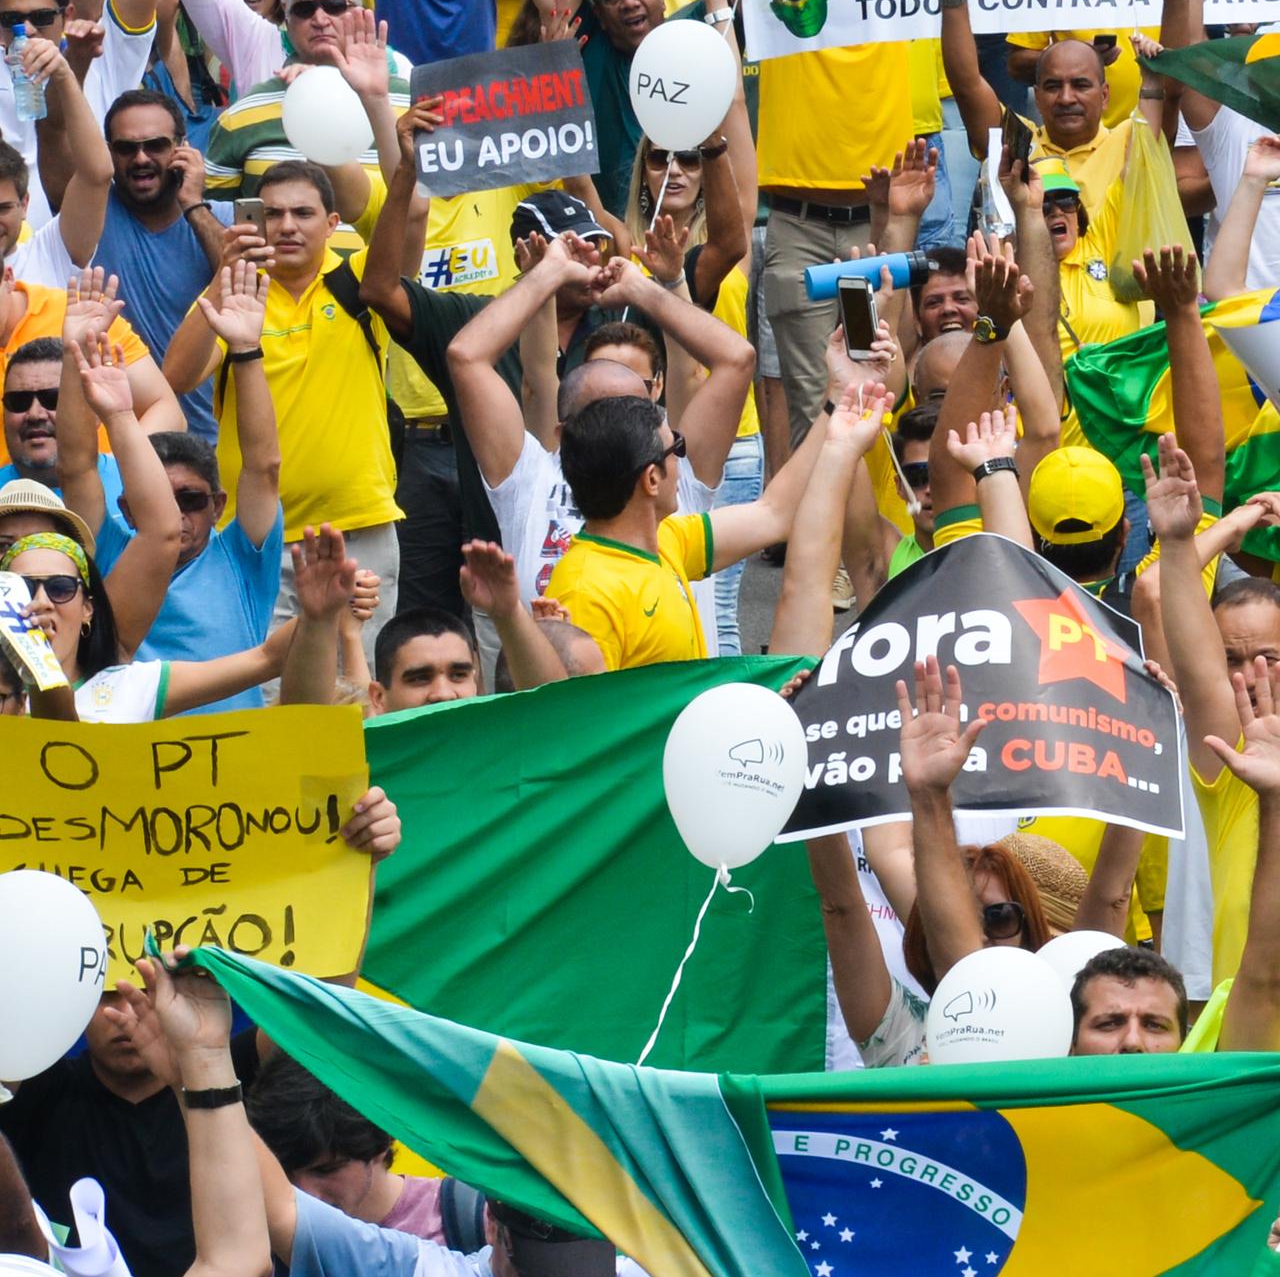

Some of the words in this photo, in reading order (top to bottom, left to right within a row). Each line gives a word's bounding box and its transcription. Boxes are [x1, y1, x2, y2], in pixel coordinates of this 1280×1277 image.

[415, 69, 587, 128] PEACHMENT
[637, 73, 691, 105] PAZ
[420, 142, 464, 172] EU
[478, 120, 593, 168] APOIO!
[818, 608, 1013, 687] fora
[1048, 613, 1109, 664] PT
[805, 718, 839, 744] se
[845, 706, 969, 744] que
[977, 704, 1164, 756] comunismo,
[39, 740, 99, 791] O
[152, 730, 250, 790] PT
[803, 751, 877, 791] vão
[887, 745, 988, 784] pa
[1000, 738, 1161, 795] CUBA...
[12, 864, 145, 895] EGA
[180, 862, 232, 886] DE
[78, 947, 106, 986] PA
[793, 1134, 811, 1154] E
[835, 1139, 1012, 1228] PROGRESSO
